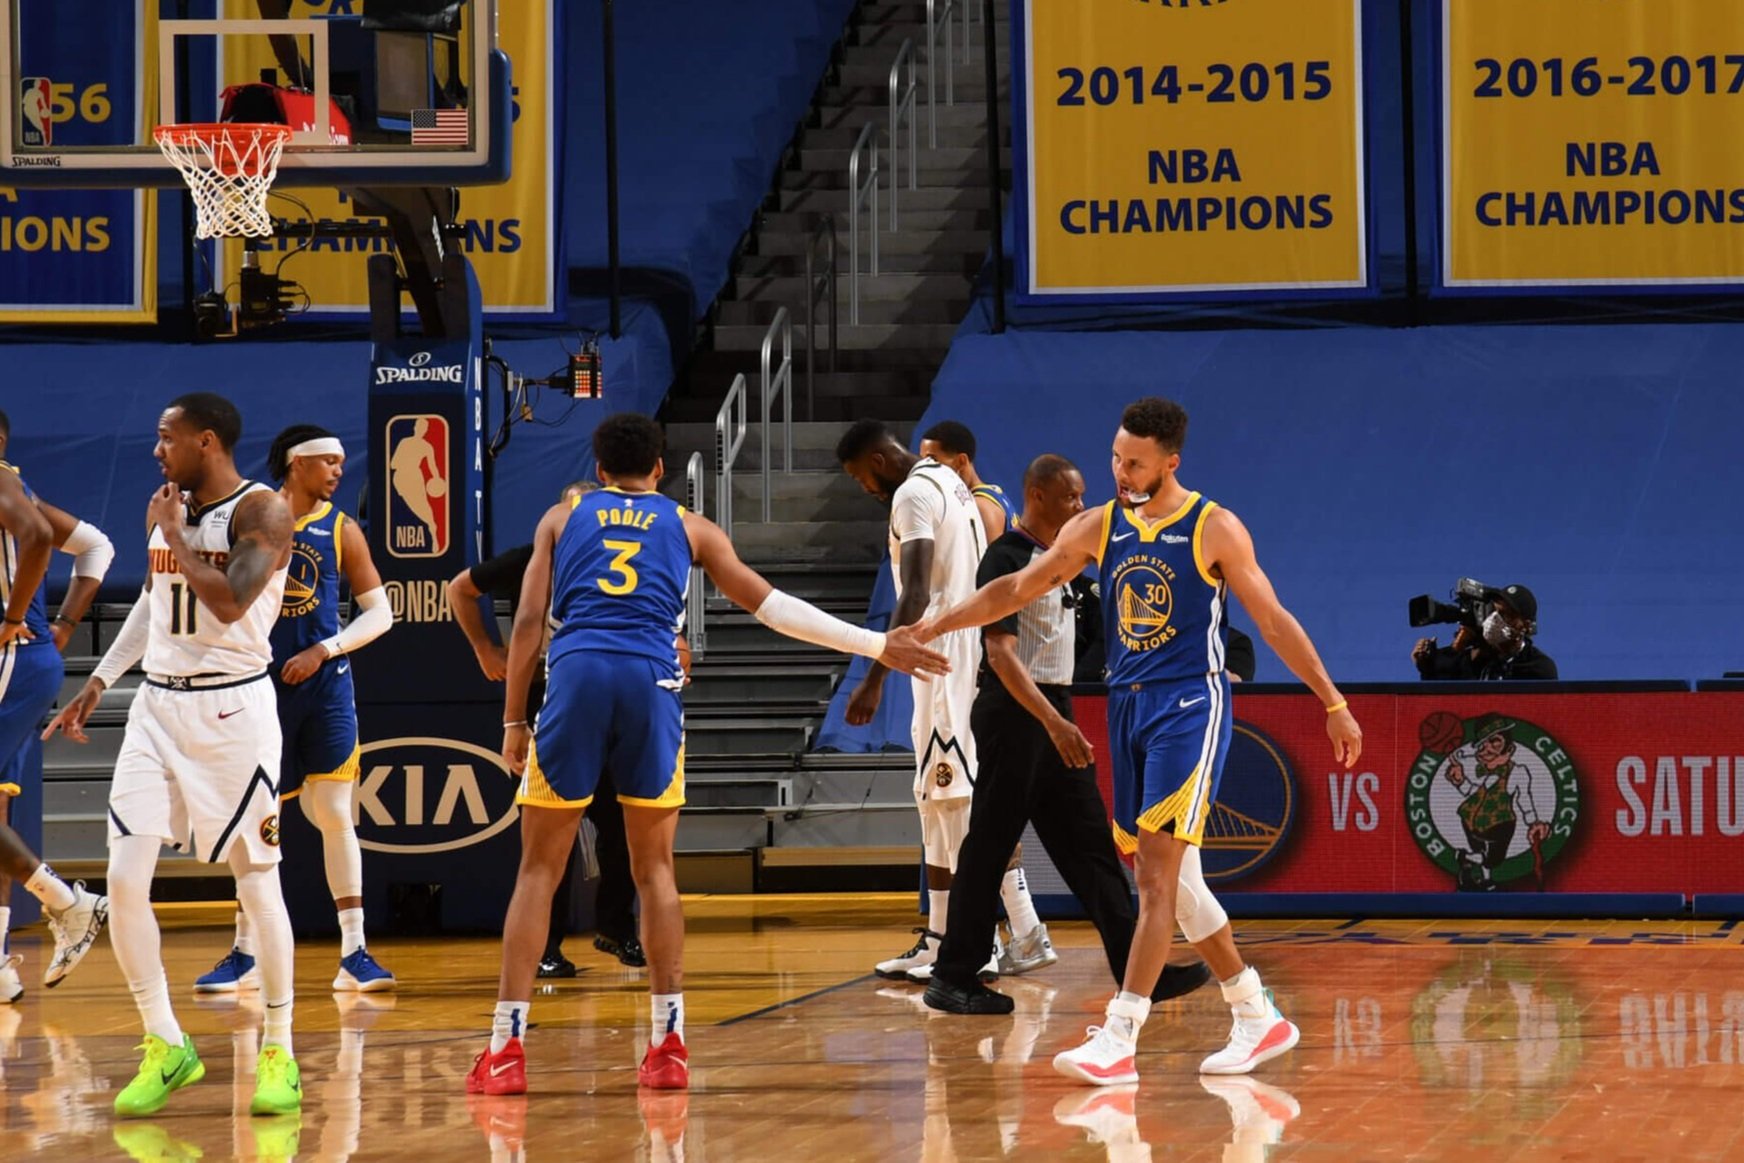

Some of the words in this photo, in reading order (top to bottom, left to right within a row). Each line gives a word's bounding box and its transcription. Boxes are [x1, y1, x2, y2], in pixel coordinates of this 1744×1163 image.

[1057, 61, 1332, 106] 2014-2015
[1474, 55, 1744, 98] 2016-2017
[12, 156, 60, 168] SPALDING
[1148, 149, 1241, 184] NBA
[1566, 142, 1660, 176] NBA
[1060, 194, 1333, 235] CHAMPIONS
[1475, 189, 1744, 227] CHAMPIONS
[375, 364, 463, 385] SPALDING
[396, 526, 426, 548] NBA
[597, 508, 658, 530] POOLE
[301, 564, 307, 580] 1
[597, 539, 641, 595] 3
[1112, 555, 1148, 579] GOLDEN
[1151, 556, 1177, 580] STATE
[170, 583, 197, 635] 11
[1144, 583, 1167, 605] 30
[354, 765, 490, 826] KIA
[1328, 772, 1379, 831] VS
[1410, 755, 1445, 857] BOSTON
[1535, 736, 1578, 837] CELTICS
[1616, 756, 1744, 837] SATU
